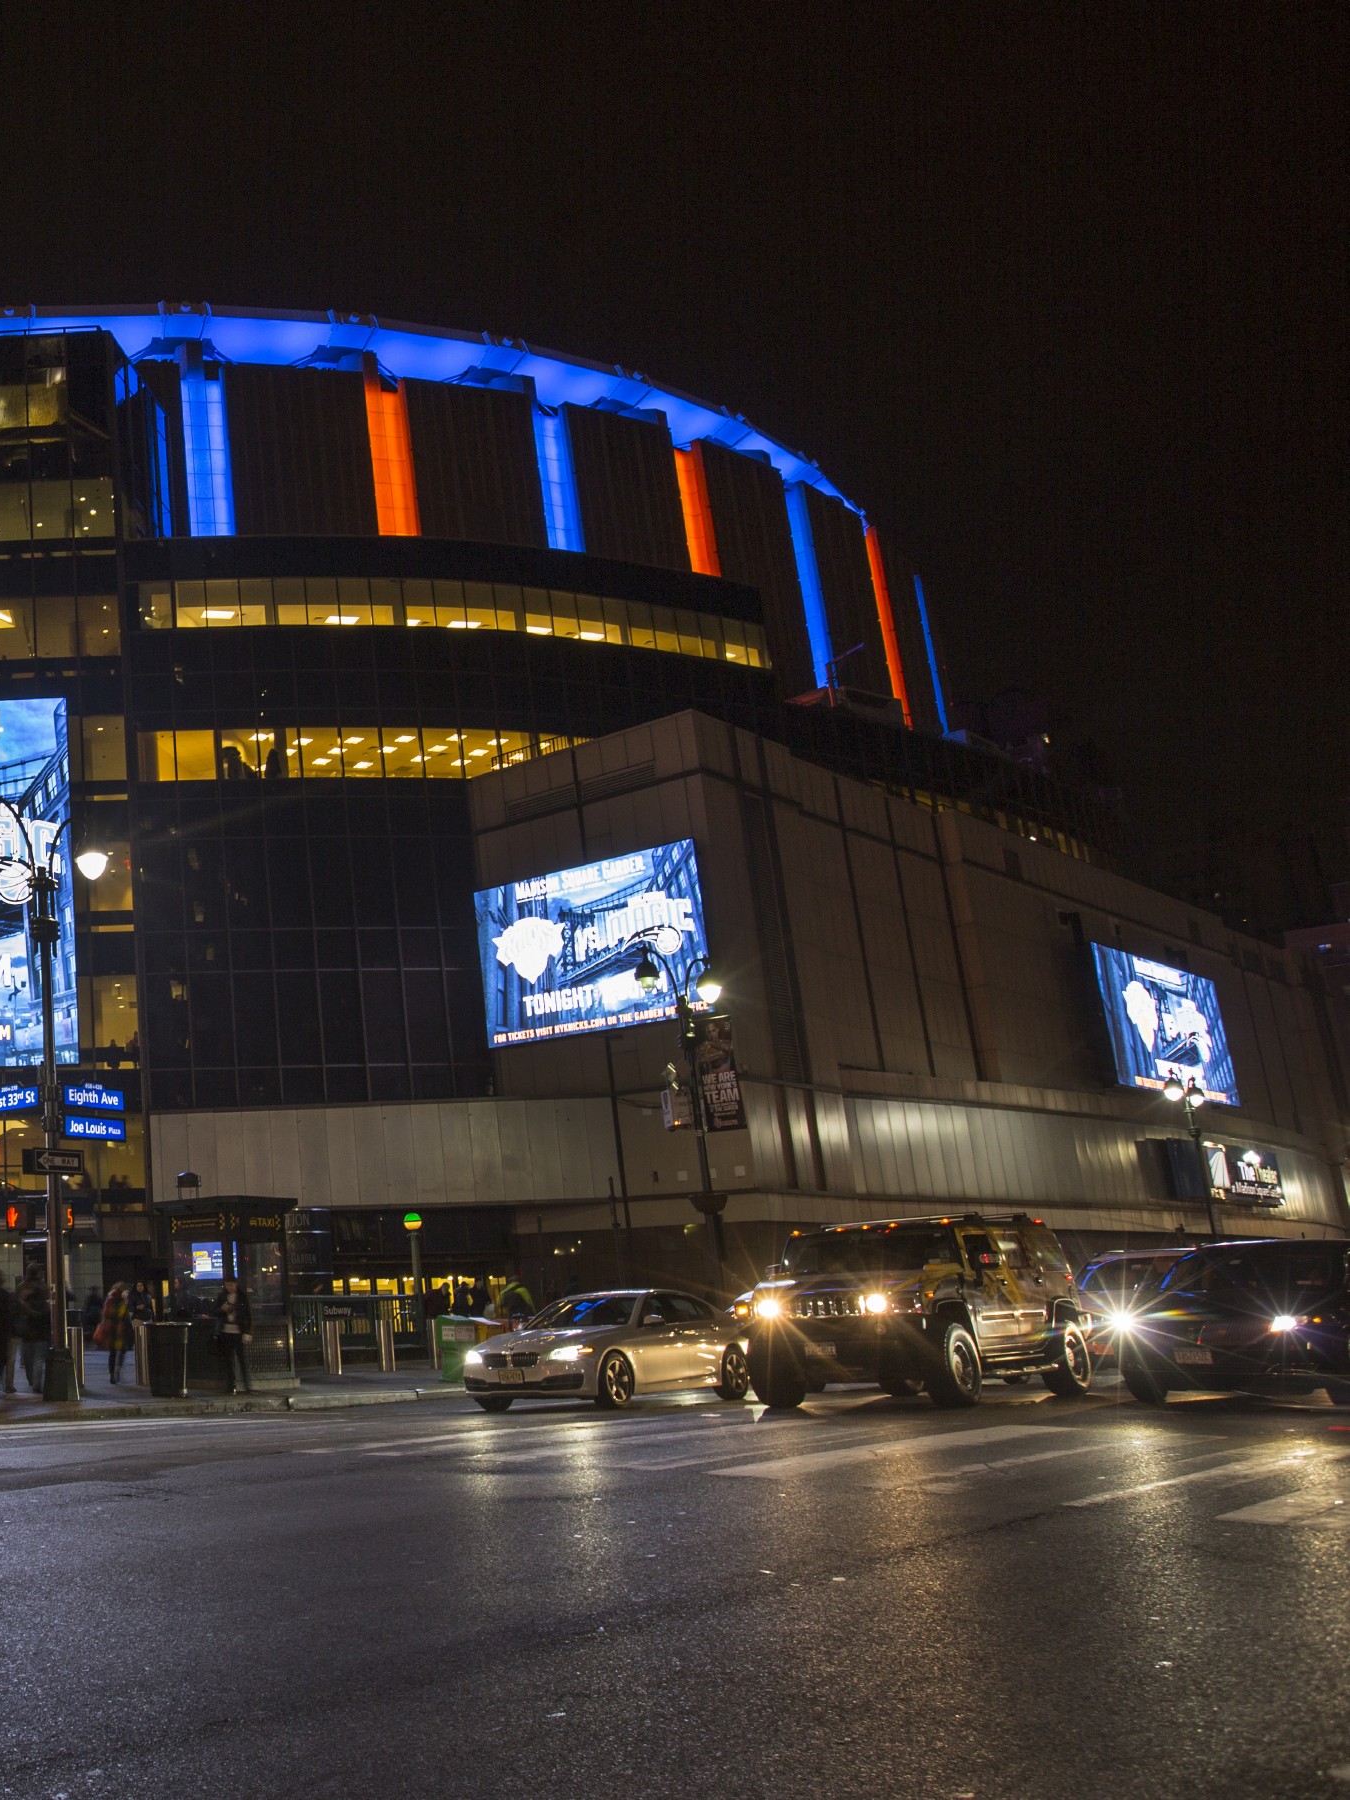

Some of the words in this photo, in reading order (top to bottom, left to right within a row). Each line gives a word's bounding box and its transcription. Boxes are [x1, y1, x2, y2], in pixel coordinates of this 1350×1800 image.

[515, 875, 560, 901] MADISON
[561, 865, 600, 890] SQUARE
[607, 897, 696, 949] MAGIC
[523, 983, 594, 1017] TONIGHT
[494, 1033, 507, 1044] FOR
[508, 1029, 534, 1042] TICKETS
[536, 1025, 553, 1037] VISIT
[555, 1018, 606, 1034] NYKNICKS.COM
[608, 1015, 617, 1026] OR
[618, 1012, 633, 1024] THE
[634, 1007, 664, 1021] GARDEN
[665, 1004, 676, 1017] BO
[702, 1073, 717, 1084] WE
[718, 1070, 736, 1083] ARE
[8, 1091, 24, 1106] 33rd
[25, 1091, 35, 1103] St
[68, 1089, 99, 1105] Eighth
[101, 1092, 119, 1106] Ave
[705, 1088, 740, 1104] TEAM
[70, 1120, 84, 1134] Joe
[86, 1121, 107, 1135] Louis
[43, 1156, 55, 1165] ONE
[61, 1157, 76, 1166] WAY
[1237, 1161, 1256, 1182] The
[257, 1217, 275, 1228] TAXI
[323, 1305, 351, 1317] Subway
